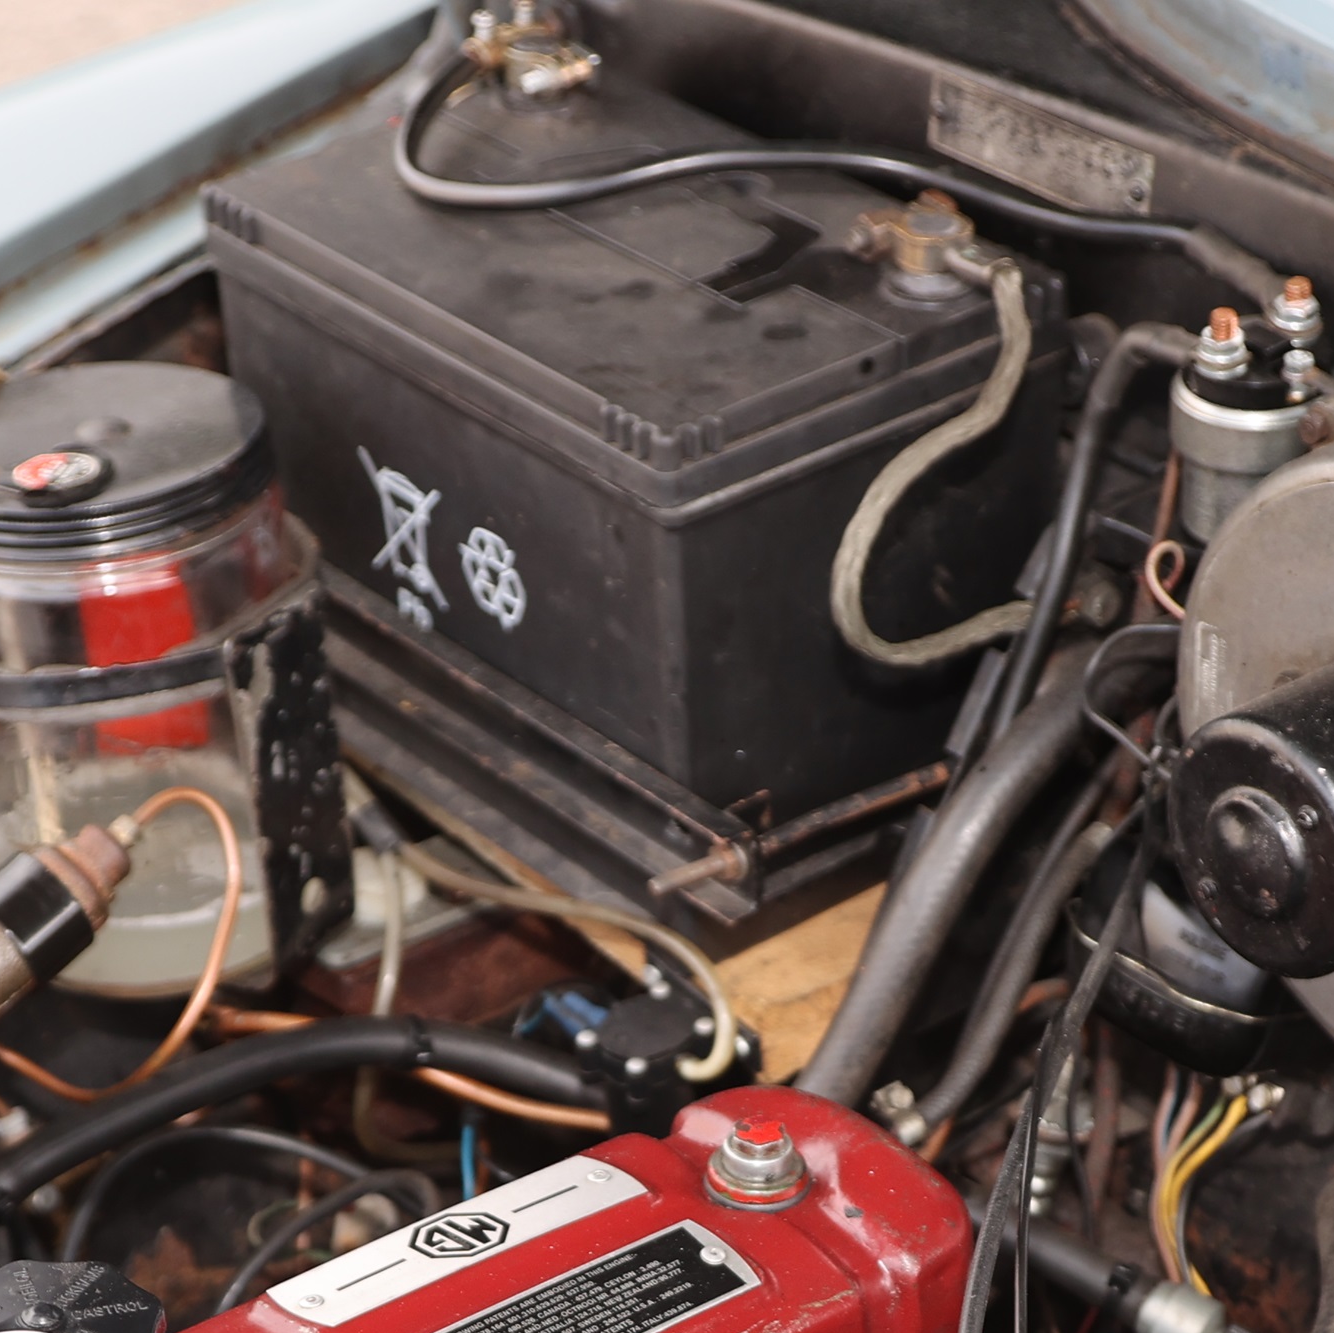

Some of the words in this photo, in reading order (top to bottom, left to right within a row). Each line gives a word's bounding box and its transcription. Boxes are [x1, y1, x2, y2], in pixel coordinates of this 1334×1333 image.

[70, 1299, 149, 1321] CASTROL
[482, 1304, 521, 1325] PATENTS
[516, 1296, 537, 1309] ARE
[533, 1278, 578, 1301] EMBODIED
[583, 1265, 605, 1278] THIS
[535, 1299, 573, 1319] CANADA
[601, 1269, 638, 1289] CEYLON
